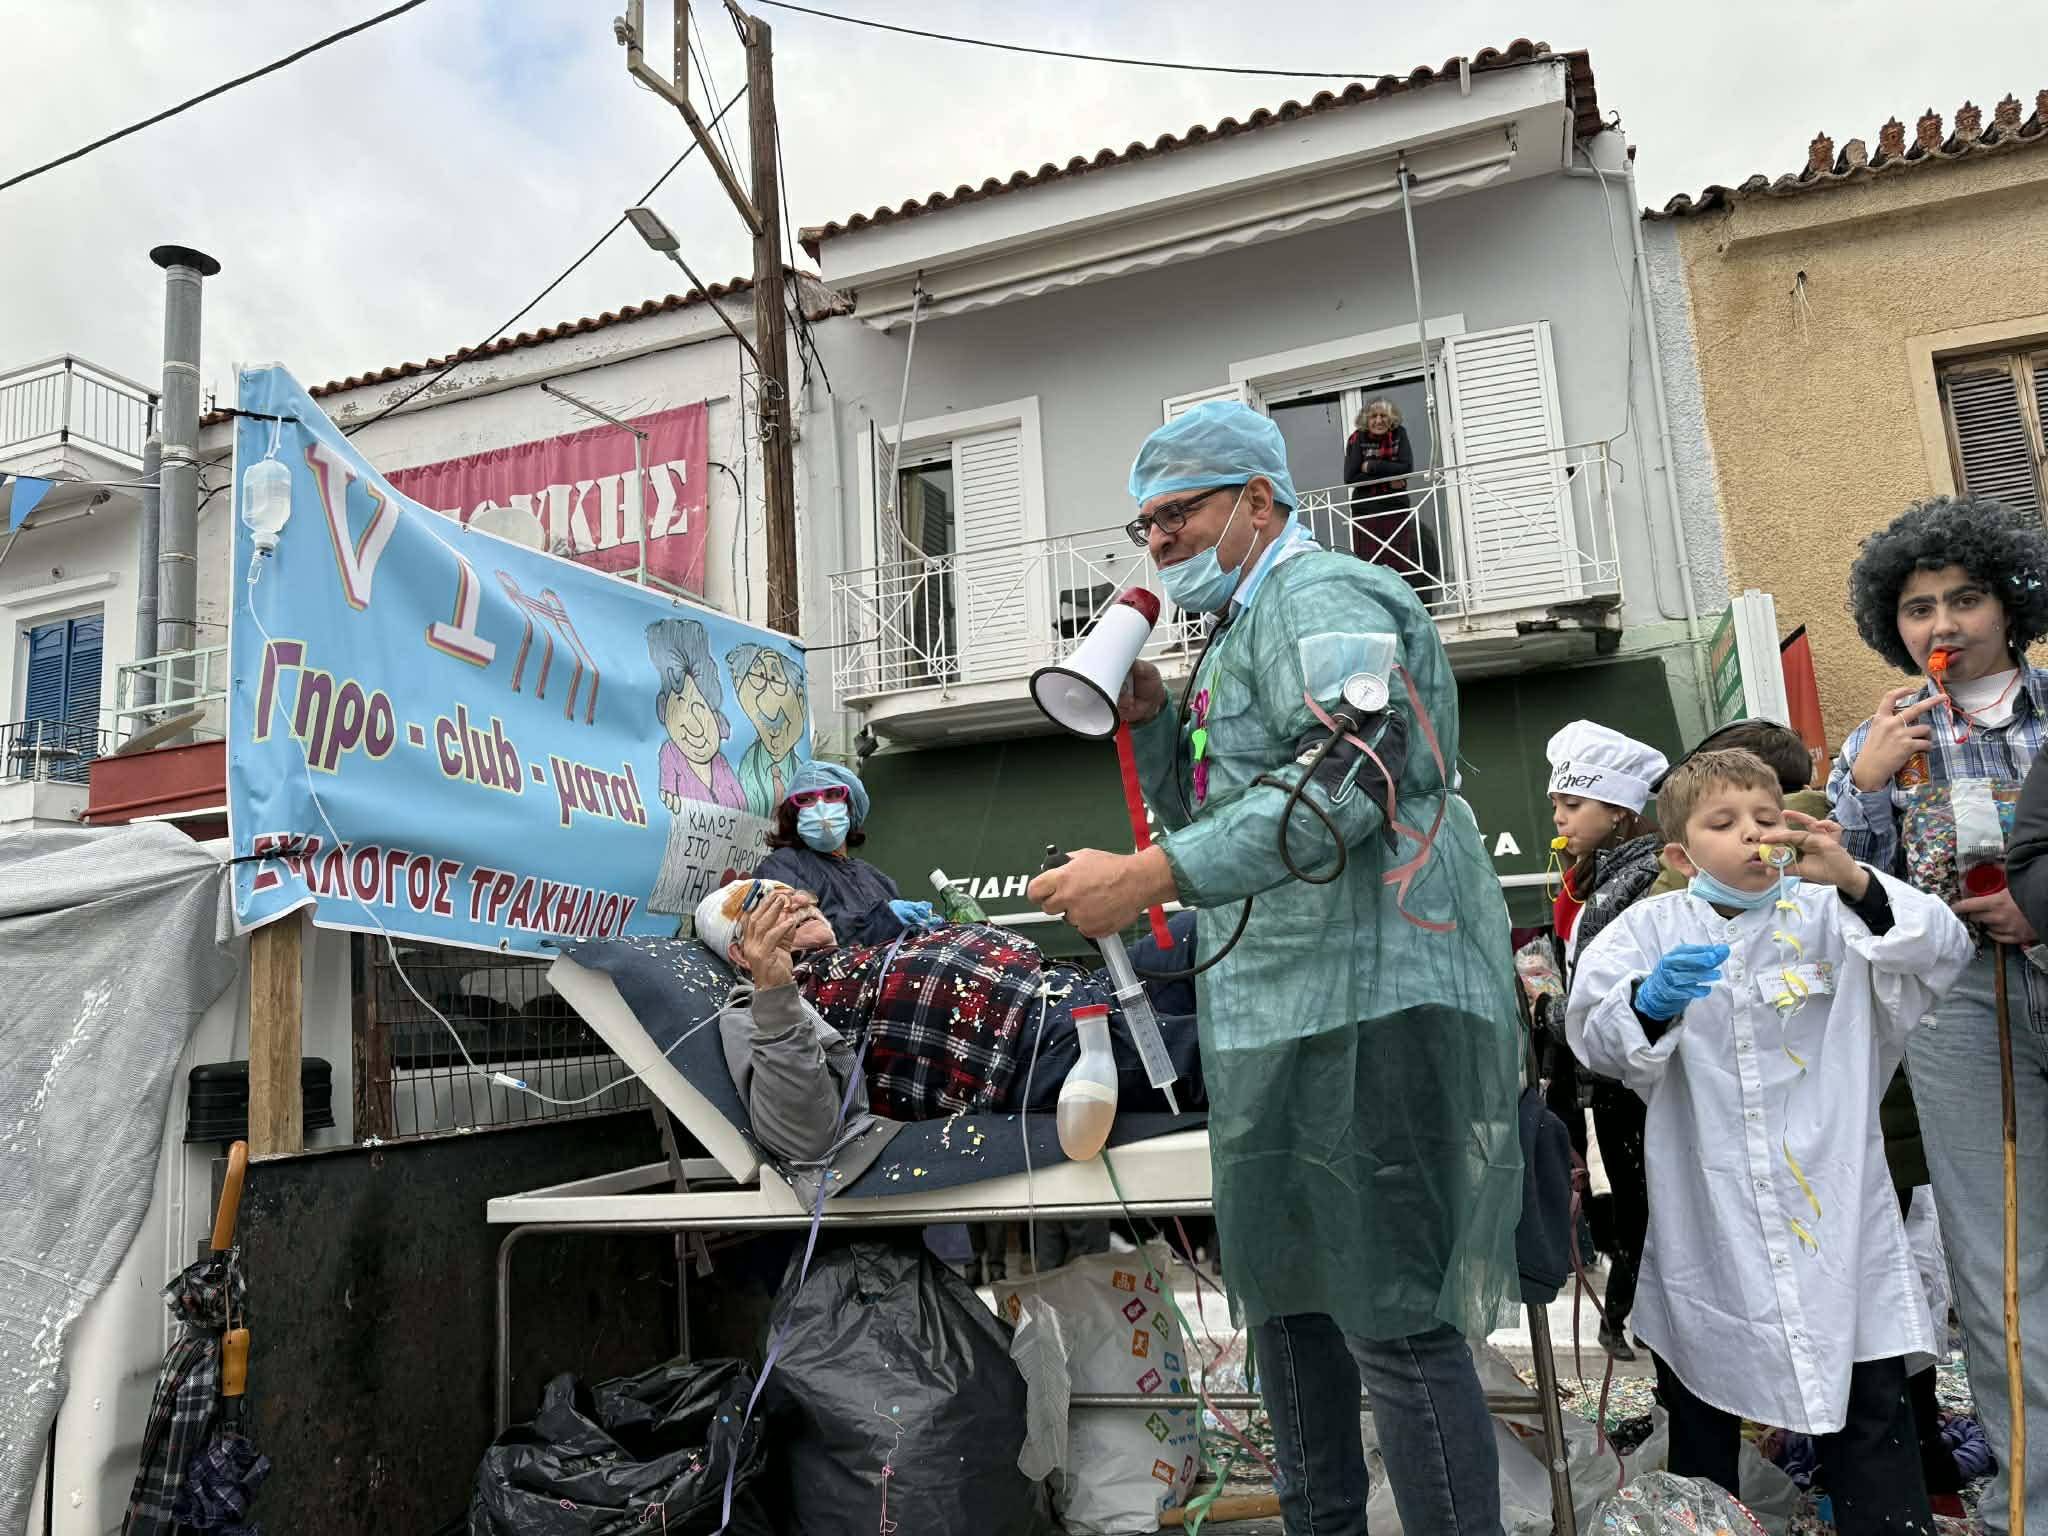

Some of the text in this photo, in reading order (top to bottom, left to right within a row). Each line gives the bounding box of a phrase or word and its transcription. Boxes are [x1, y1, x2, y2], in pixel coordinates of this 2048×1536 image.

[253, 637, 397, 775] Γηρο
[434, 700, 524, 796] club
[549, 754, 648, 828] ματα!
[684, 836, 710, 860] ΣΤΟ
[470, 865, 638, 937] ΤΡΑΧΗΛΙΟΥ
